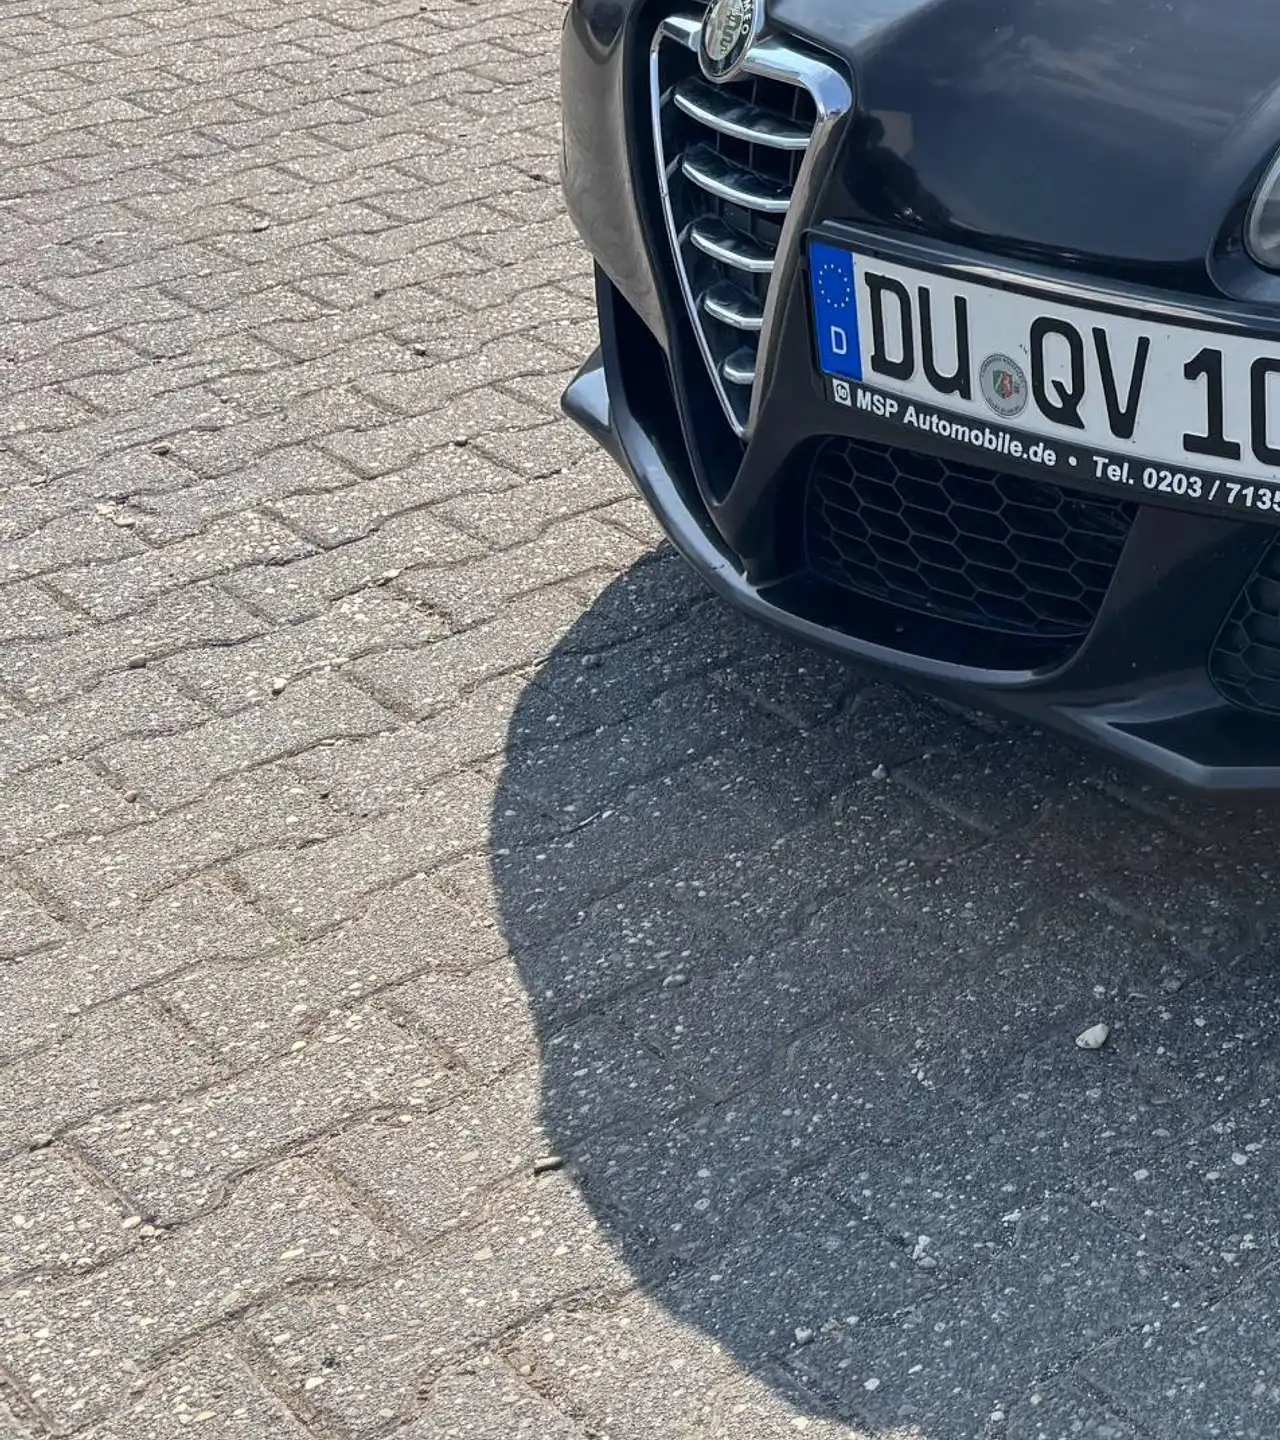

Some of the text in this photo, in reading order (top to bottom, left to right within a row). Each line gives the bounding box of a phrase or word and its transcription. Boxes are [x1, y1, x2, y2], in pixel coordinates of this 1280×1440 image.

[831, 326, 847, 355] D
[864, 271, 972, 400] DU
[1029, 316, 1150, 439] QV
[856, 389, 898, 418] MSP
[903, 406, 1057, 467] Automobile.de
[1093, 456, 1134, 485] Tel.
[1143, 467, 1202, 498] 0203
[1208, 480, 1220, 501] /
